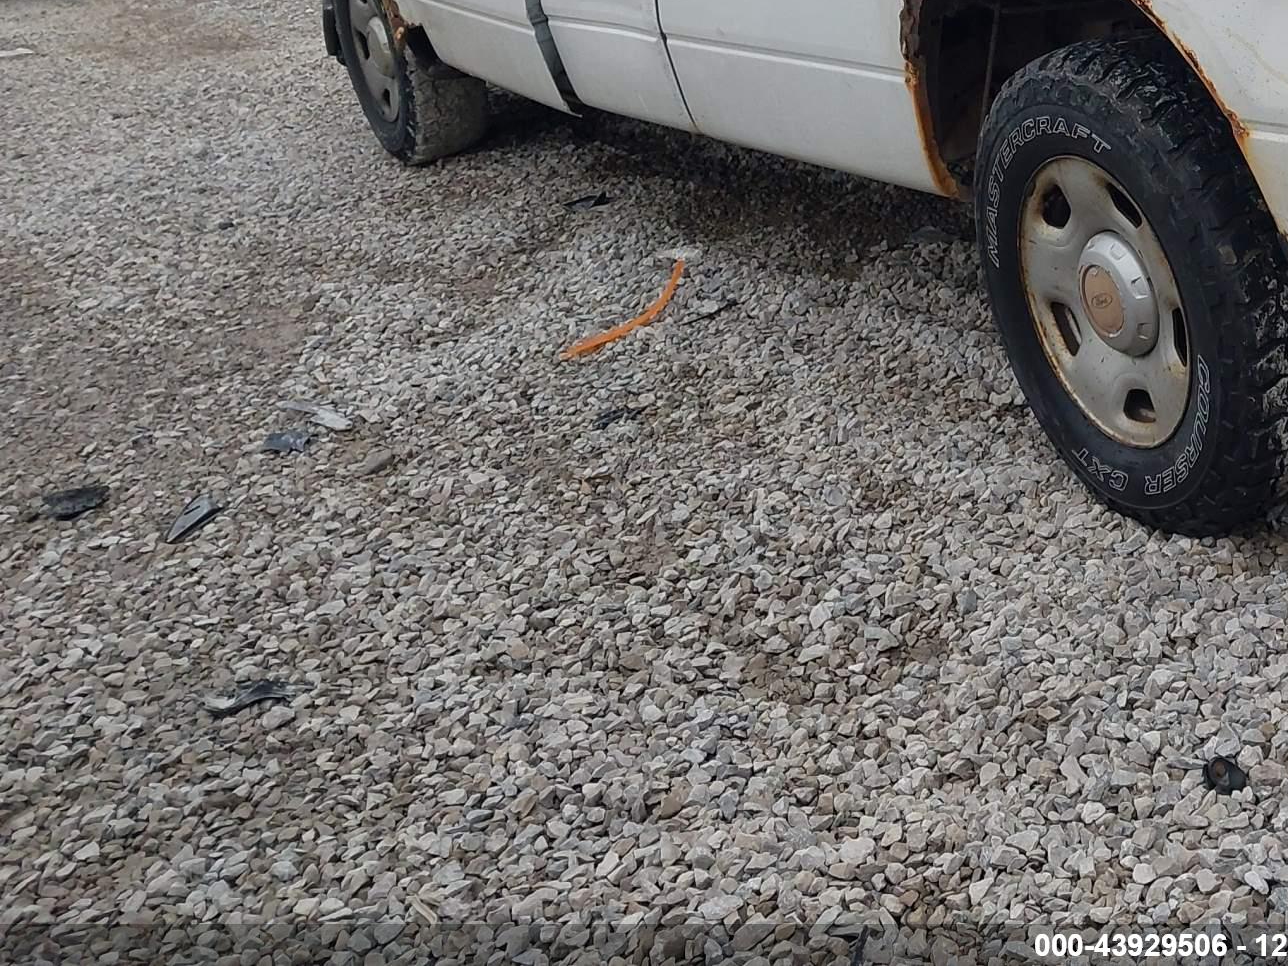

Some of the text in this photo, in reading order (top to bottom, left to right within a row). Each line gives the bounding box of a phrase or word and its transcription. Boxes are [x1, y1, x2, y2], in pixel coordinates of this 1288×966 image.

[985, 115, 1112, 269] MASTERCRAFT
[1071, 354, 1212, 495] COURSER CXT
